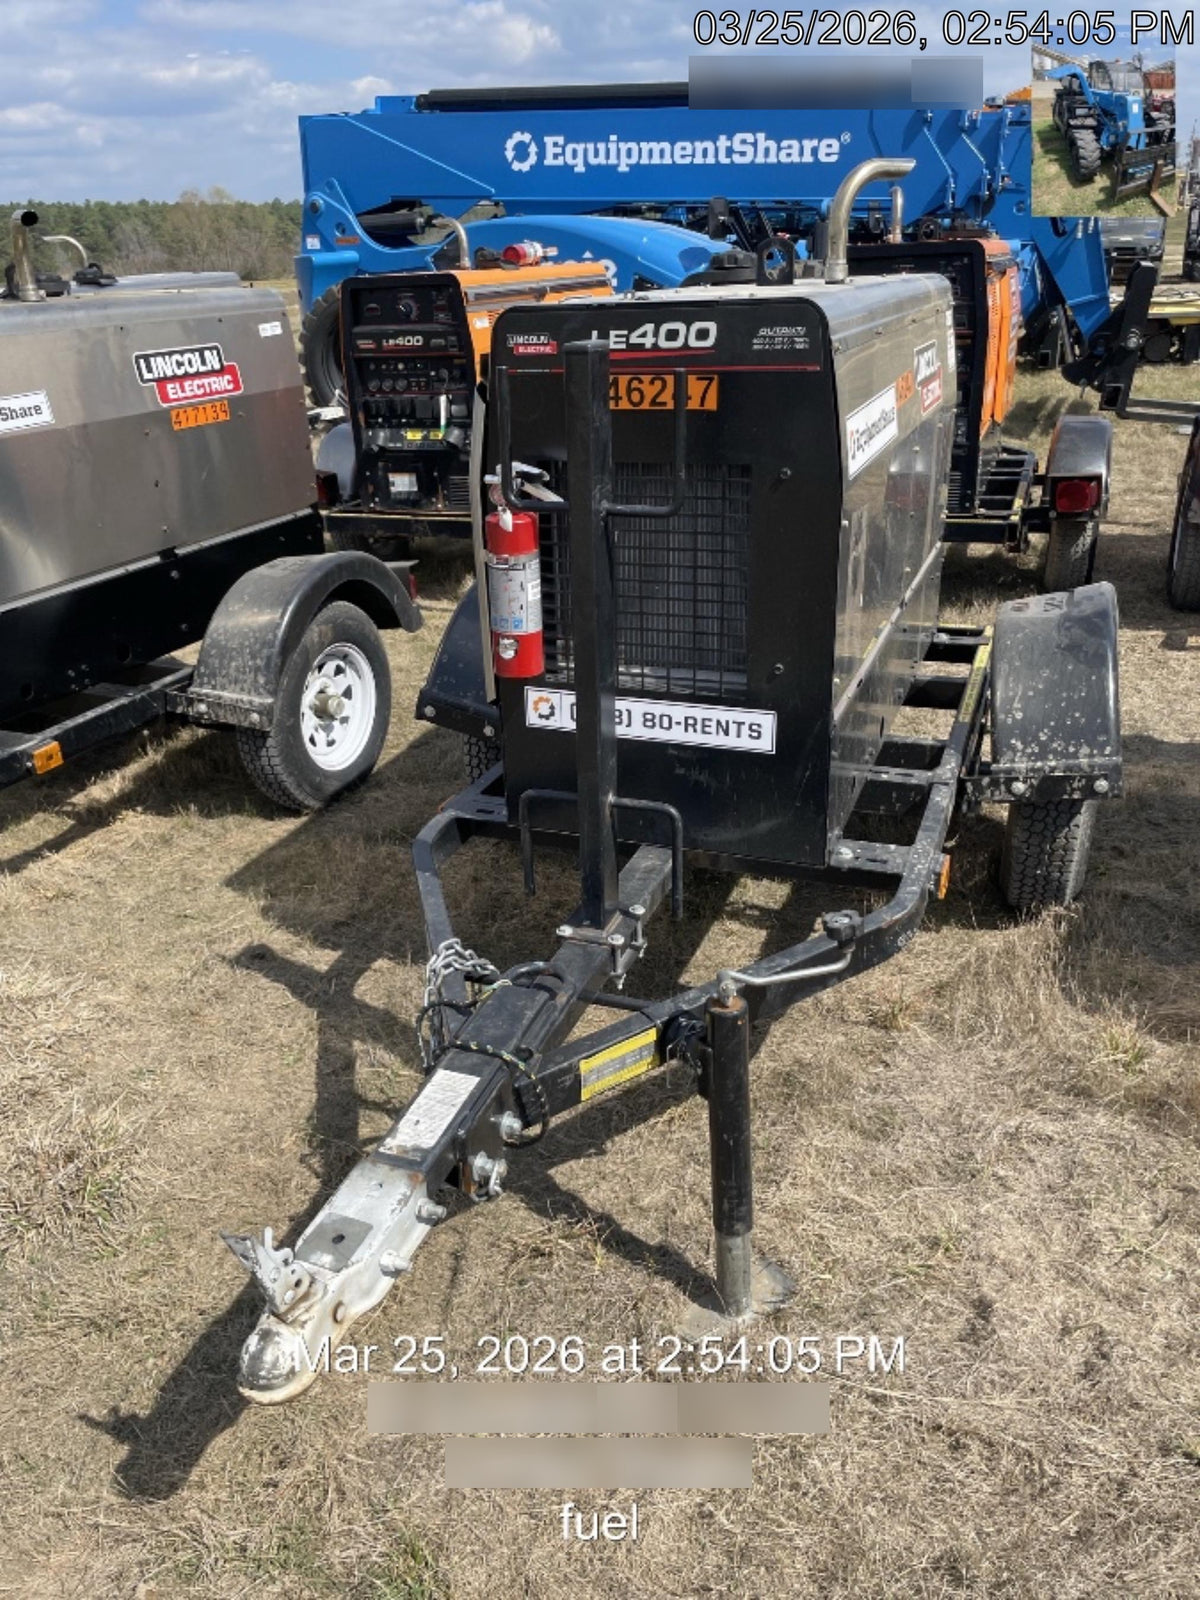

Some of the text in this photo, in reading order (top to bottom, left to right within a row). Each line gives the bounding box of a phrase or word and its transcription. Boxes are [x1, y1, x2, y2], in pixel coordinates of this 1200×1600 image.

[137, 349, 223, 380] LINCOLN
[166, 374, 235, 400] ELECTRIC
[608, 375, 716, 408] 4627
[642, 711, 763, 741] 80-RENTS
